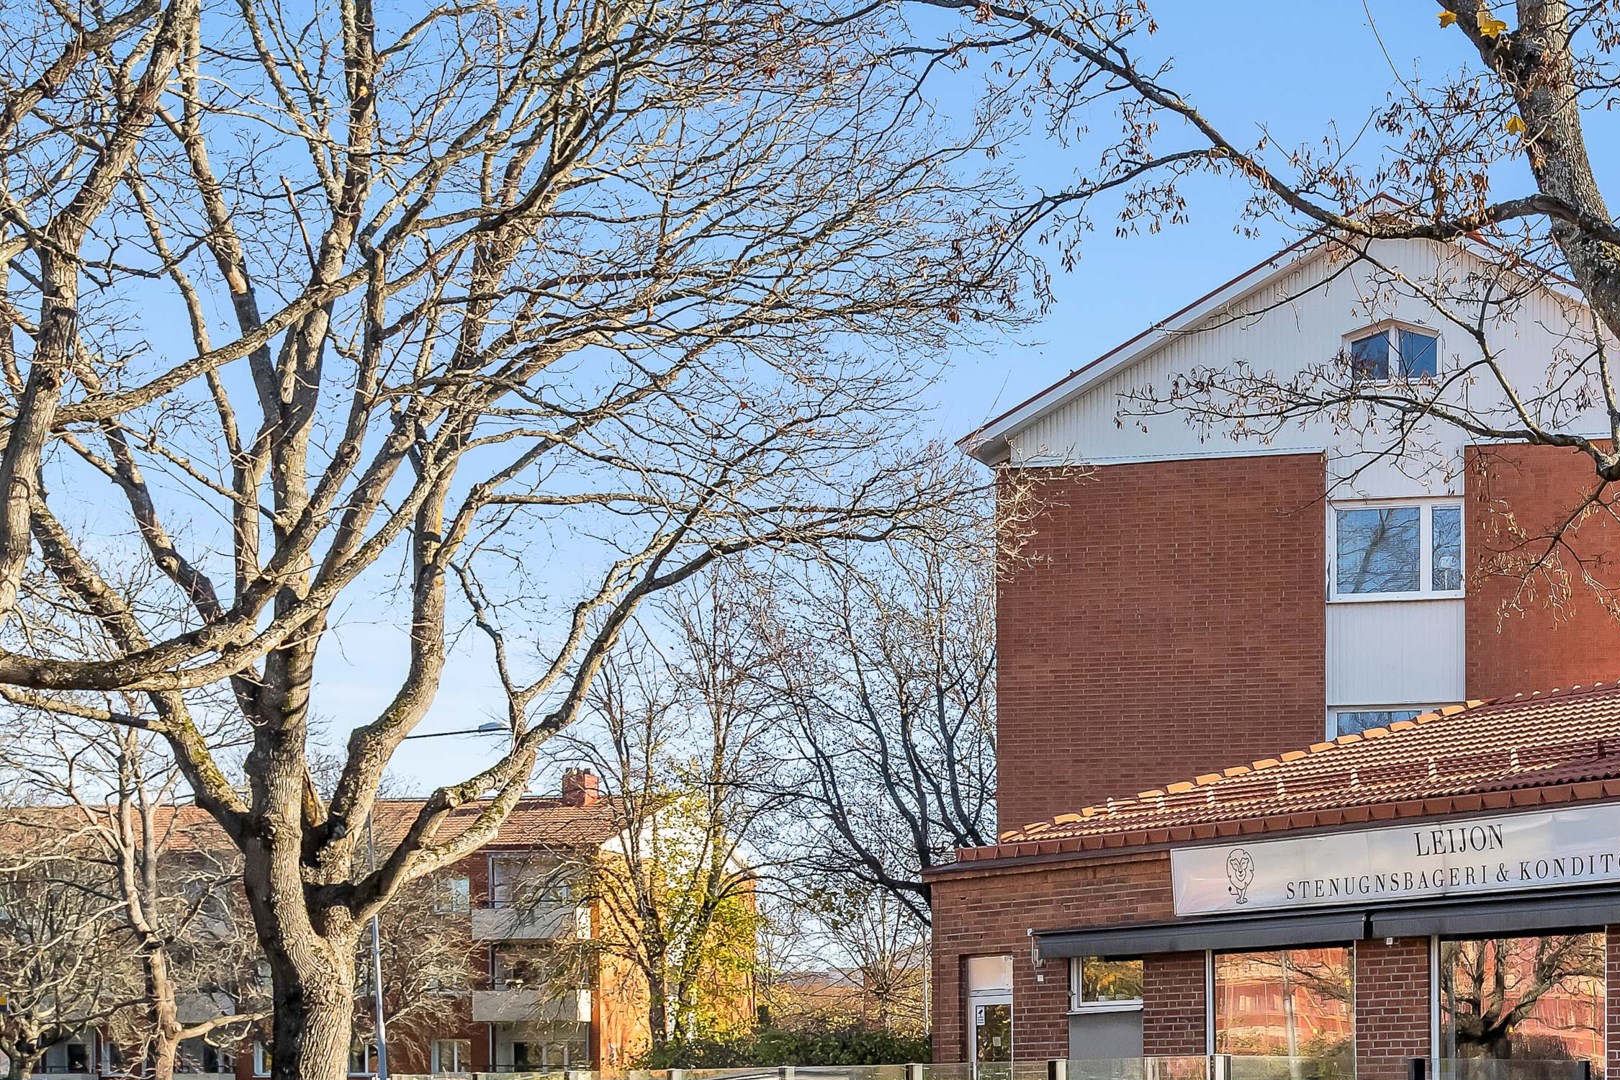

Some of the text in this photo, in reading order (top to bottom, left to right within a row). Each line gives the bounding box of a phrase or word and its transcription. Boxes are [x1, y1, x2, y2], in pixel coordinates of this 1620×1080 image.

[1413, 823, 1504, 857] LEIJON
[1285, 864, 1489, 901] STENUGNSBAGERI
[1496, 862, 1510, 883] &
